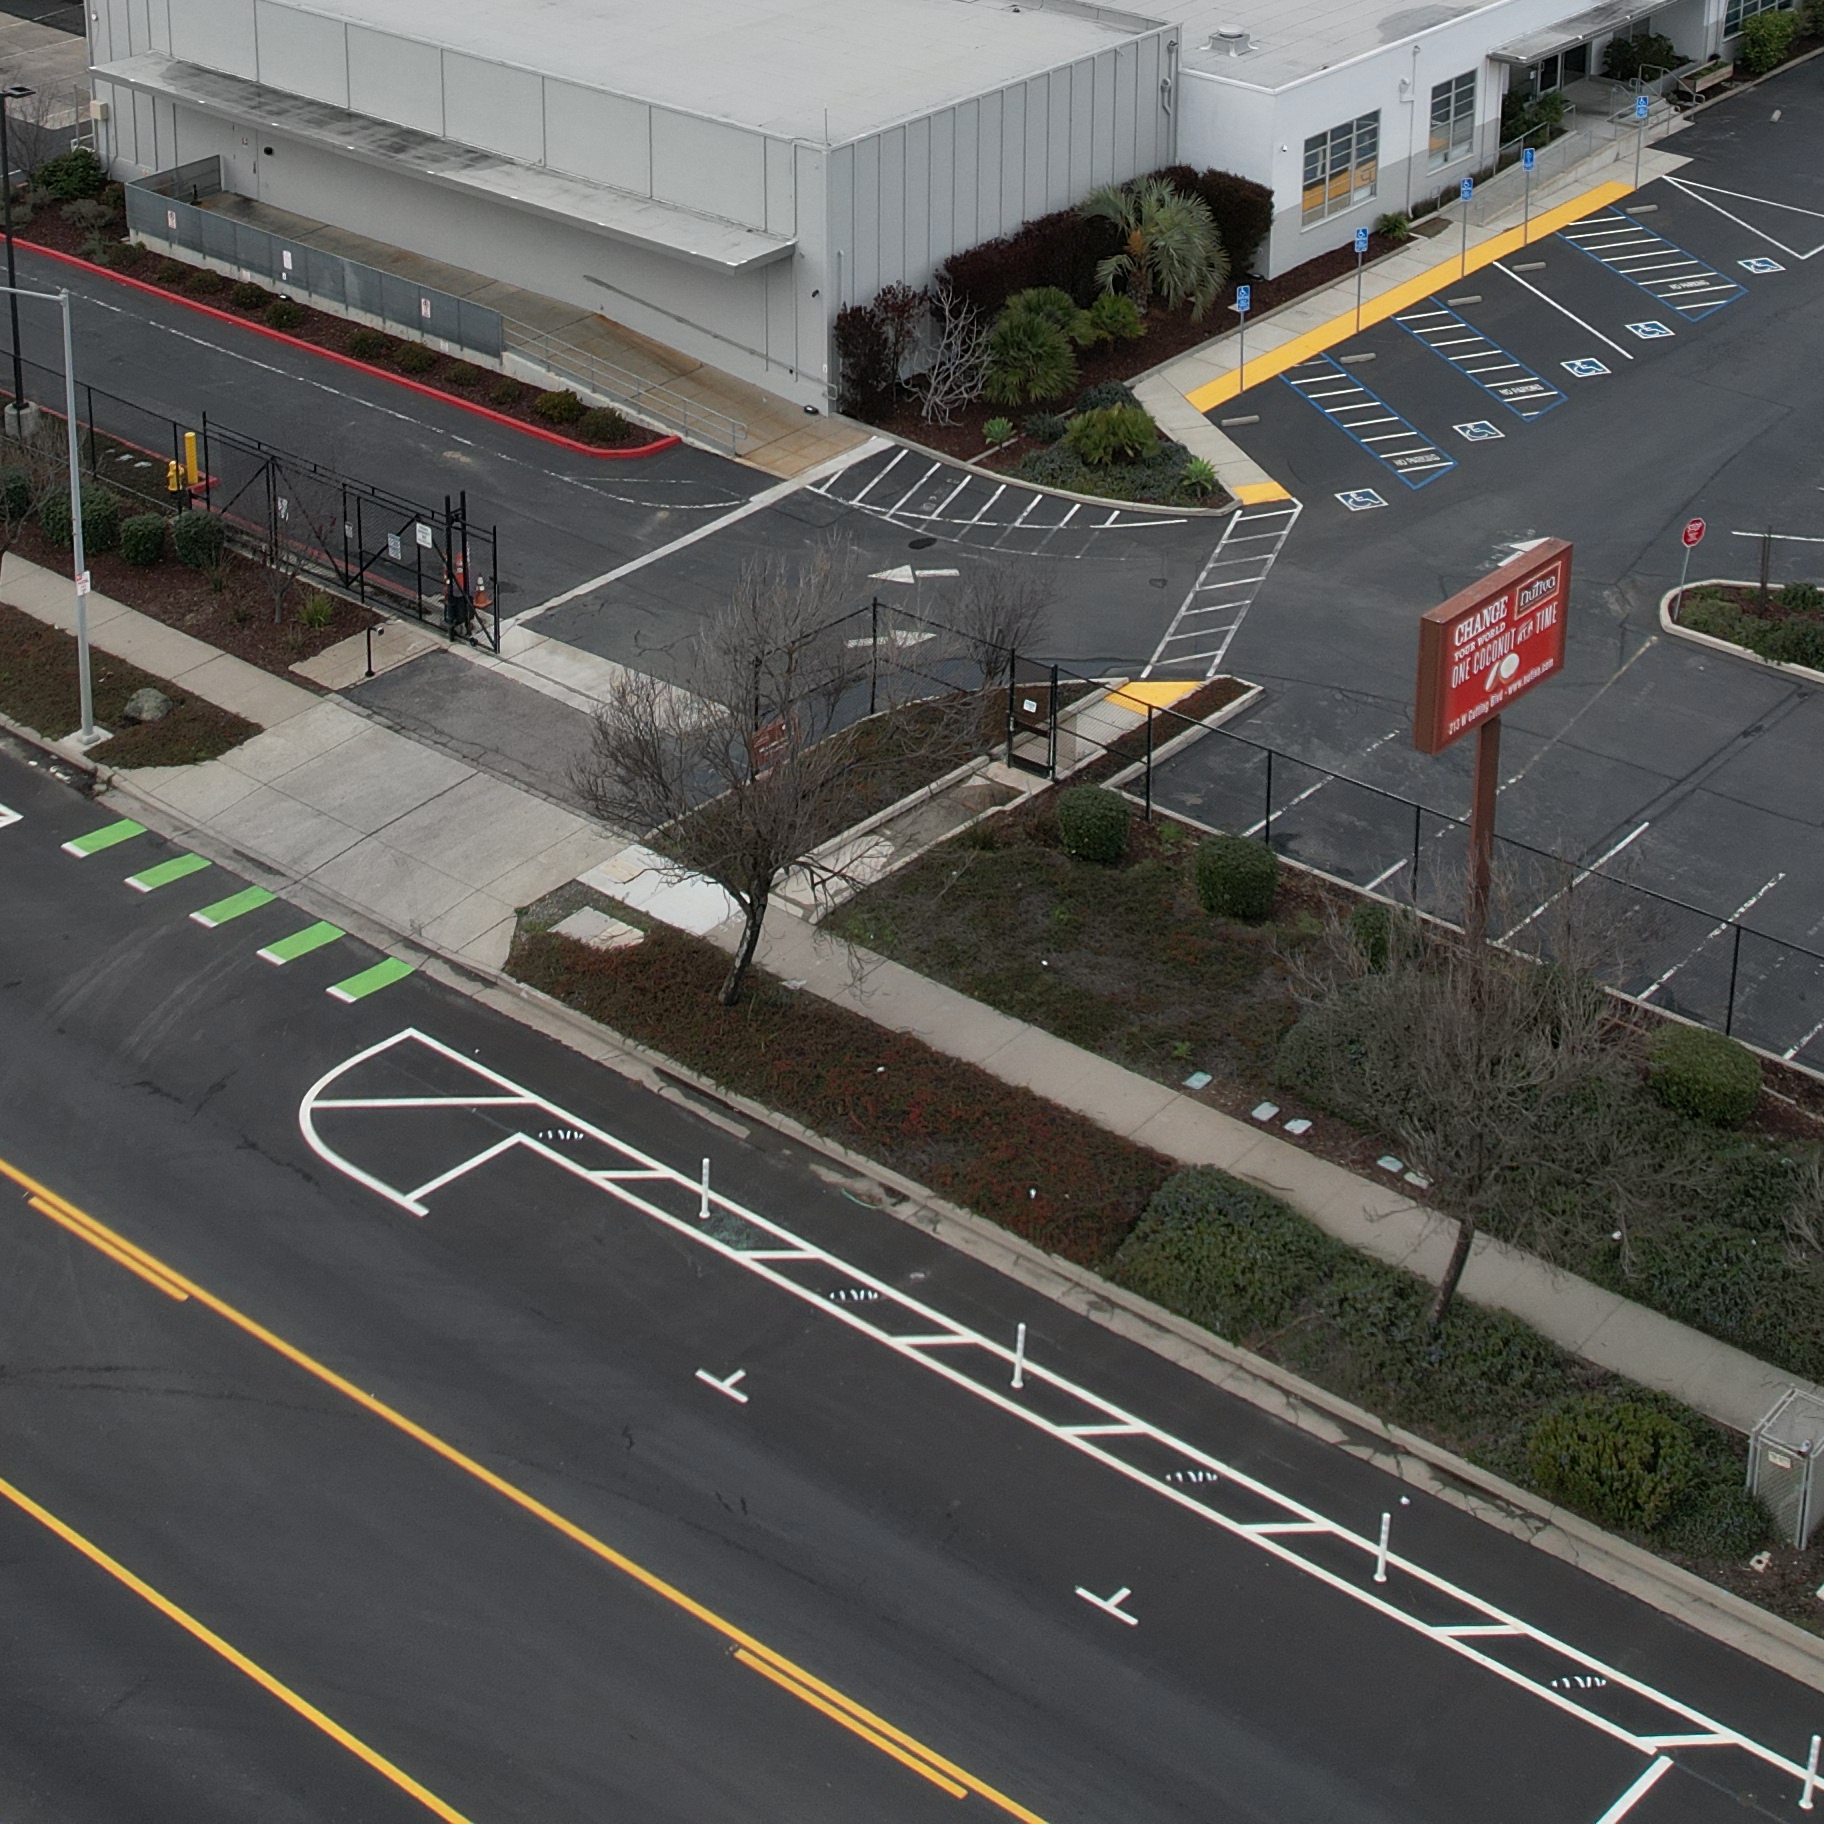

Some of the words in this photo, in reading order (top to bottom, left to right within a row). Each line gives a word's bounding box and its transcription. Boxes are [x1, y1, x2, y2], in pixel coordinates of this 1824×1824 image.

[1520, 576, 1556, 607] nutiva
[1454, 595, 1509, 647] CHANGE
[1454, 642, 1476, 662] YOUR
[1477, 622, 1506, 647] WORLD
[1452, 657, 1472, 689] ONE
[1473, 628, 1516, 675] COCONUT
[1535, 601, 1558, 634] TIME
